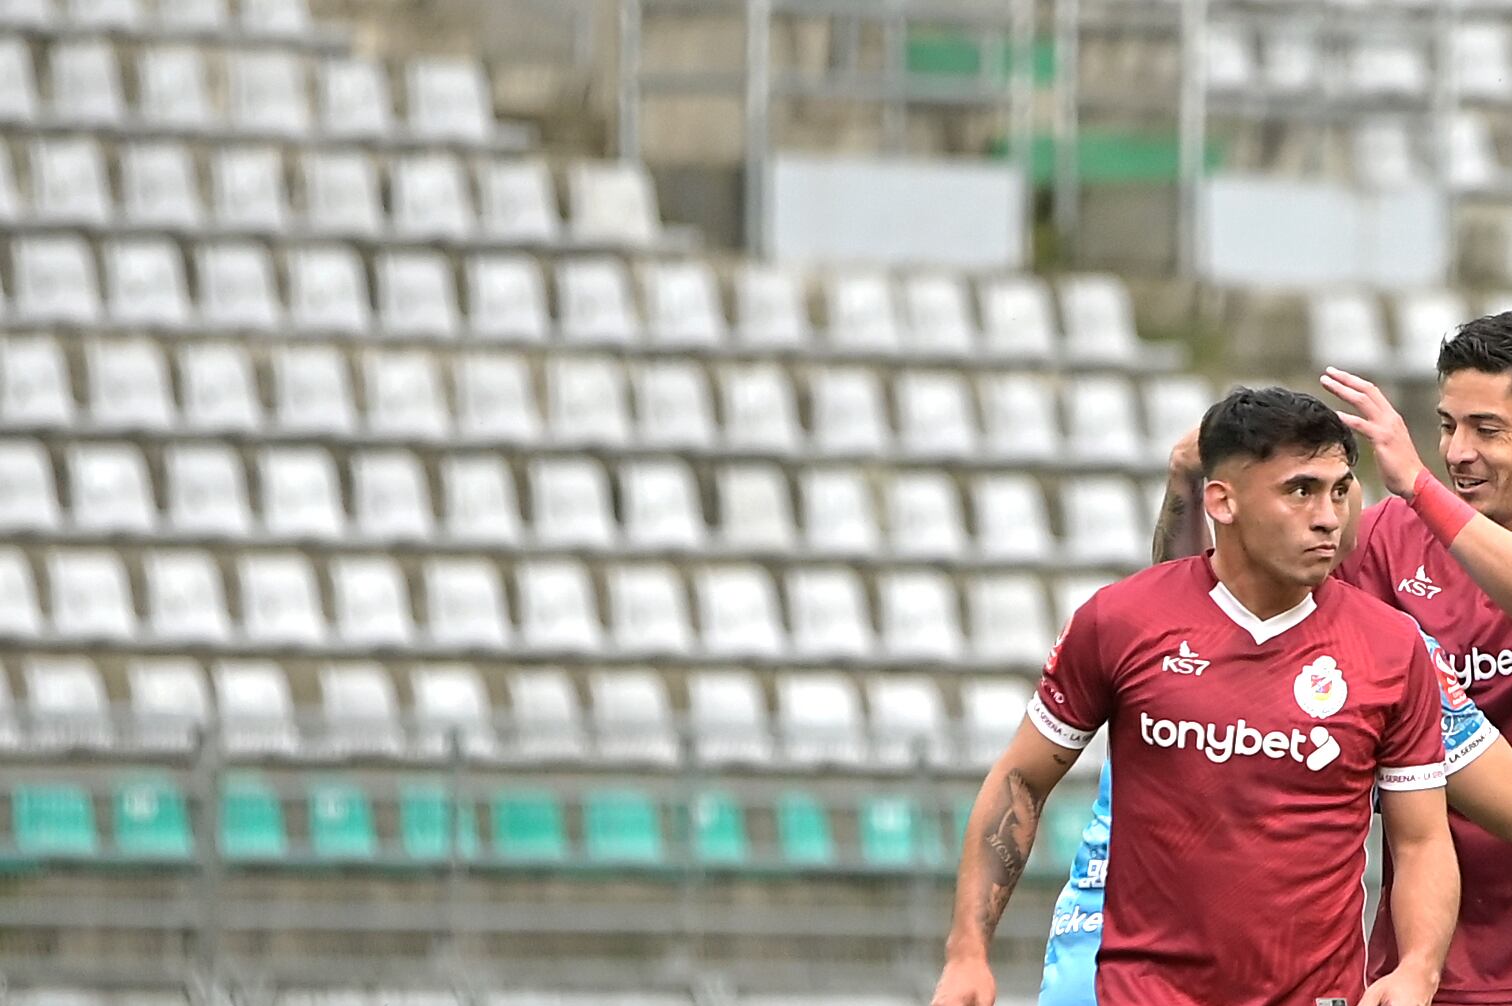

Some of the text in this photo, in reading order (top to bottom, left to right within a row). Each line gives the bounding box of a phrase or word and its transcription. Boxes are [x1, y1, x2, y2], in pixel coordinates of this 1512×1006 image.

[1398, 577, 1441, 599] KS7
[1162, 655, 1211, 676] KS7
[1140, 712, 1307, 763] tonybet
[1449, 752, 1460, 763] LA
[1460, 735, 1485, 757] SERENA
[1385, 774, 1416, 782] SERENA
[1049, 904, 1104, 936] icke
